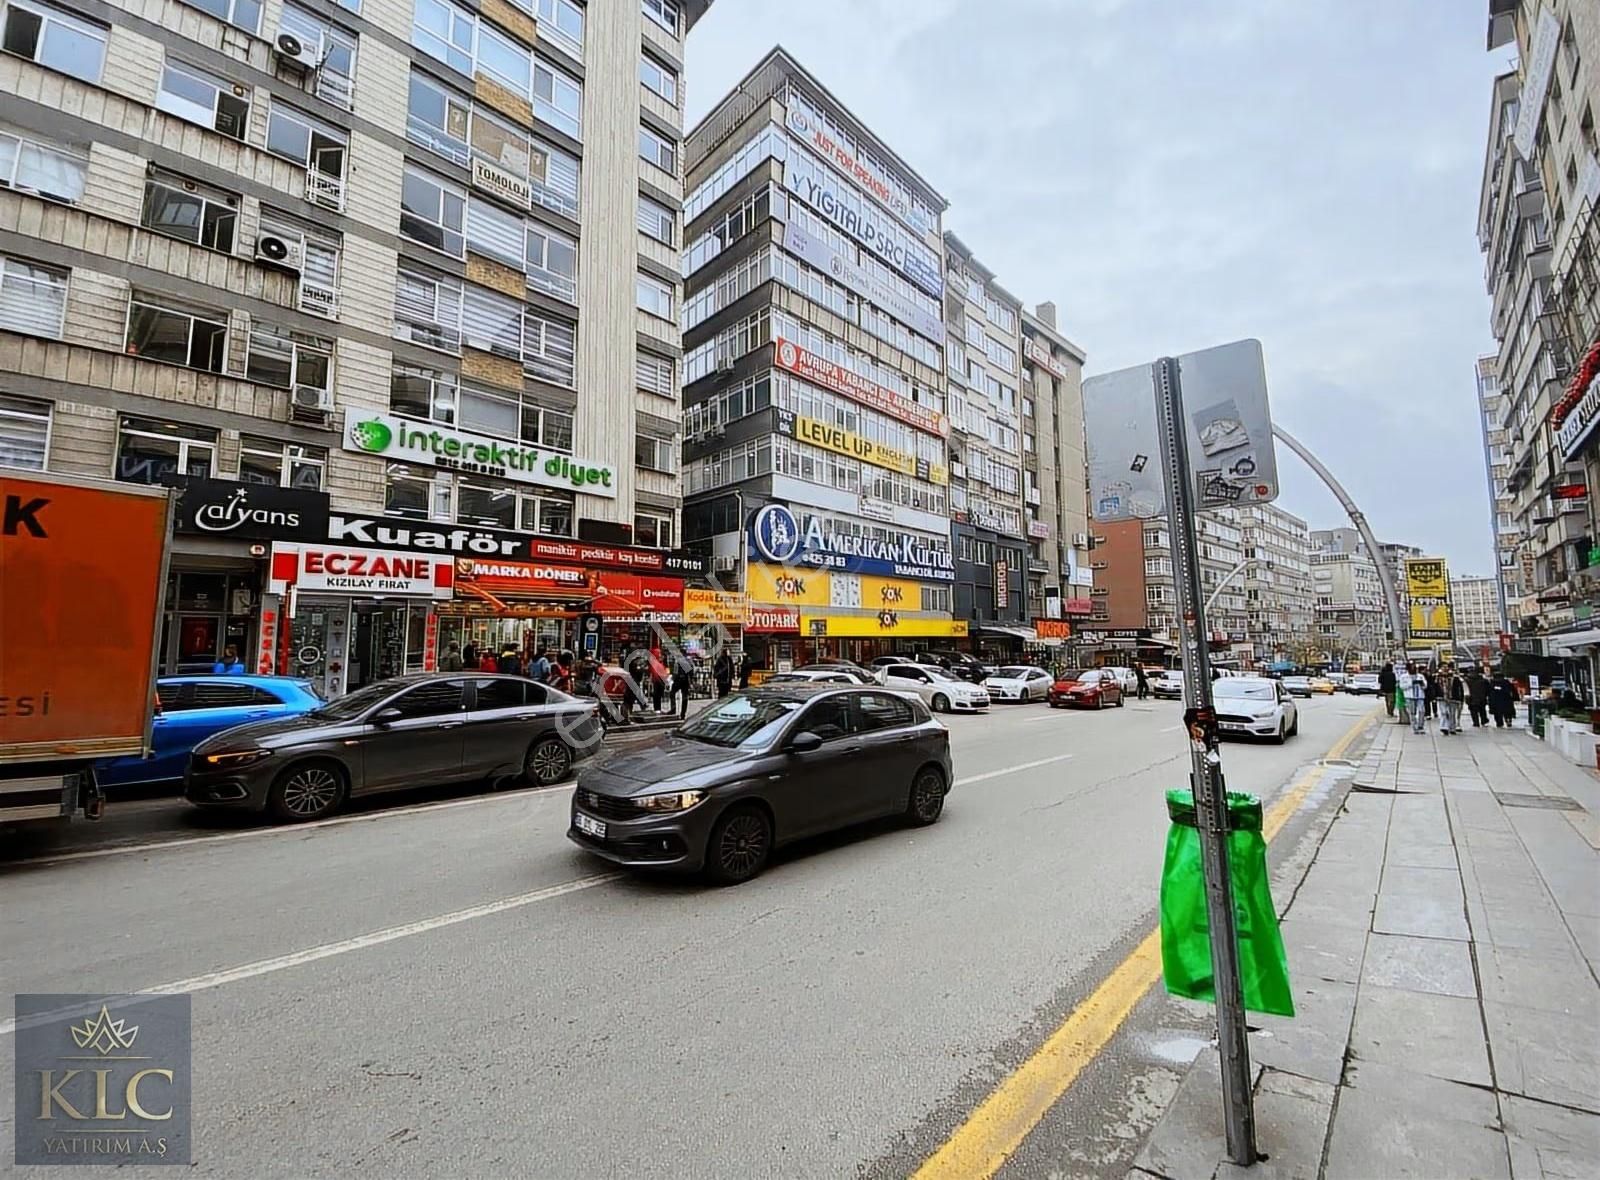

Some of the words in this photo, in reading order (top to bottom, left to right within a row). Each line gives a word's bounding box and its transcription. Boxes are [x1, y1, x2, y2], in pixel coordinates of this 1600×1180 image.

[876, 232, 903, 265] SRC
[800, 351, 839, 378] AVRUPA
[840, 369, 877, 397] YABANCI
[399, 420, 538, 472] interaktif
[545, 455, 612, 487] diyet
[802, 418, 850, 451] LEVEL
[854, 437, 873, 457] UP
[3, 495, 51, 538] K
[195, 495, 300, 531] alyans
[328, 516, 522, 555] Kuaför
[537, 543, 577, 557] manikür
[581, 547, 615, 562] pedikür
[666, 557, 681, 569] 417
[683, 559, 702, 571] 0101
[305, 552, 430, 579] ECZANE
[473, 562, 531, 578] MARKA
[534, 566, 579, 582] DÖNER
[326, 577, 374, 588] KIZILAY
[378, 580, 411, 590] FIRAT
[687, 591, 714, 602] Kodak
[745, 612, 800, 629] OTOPARK
